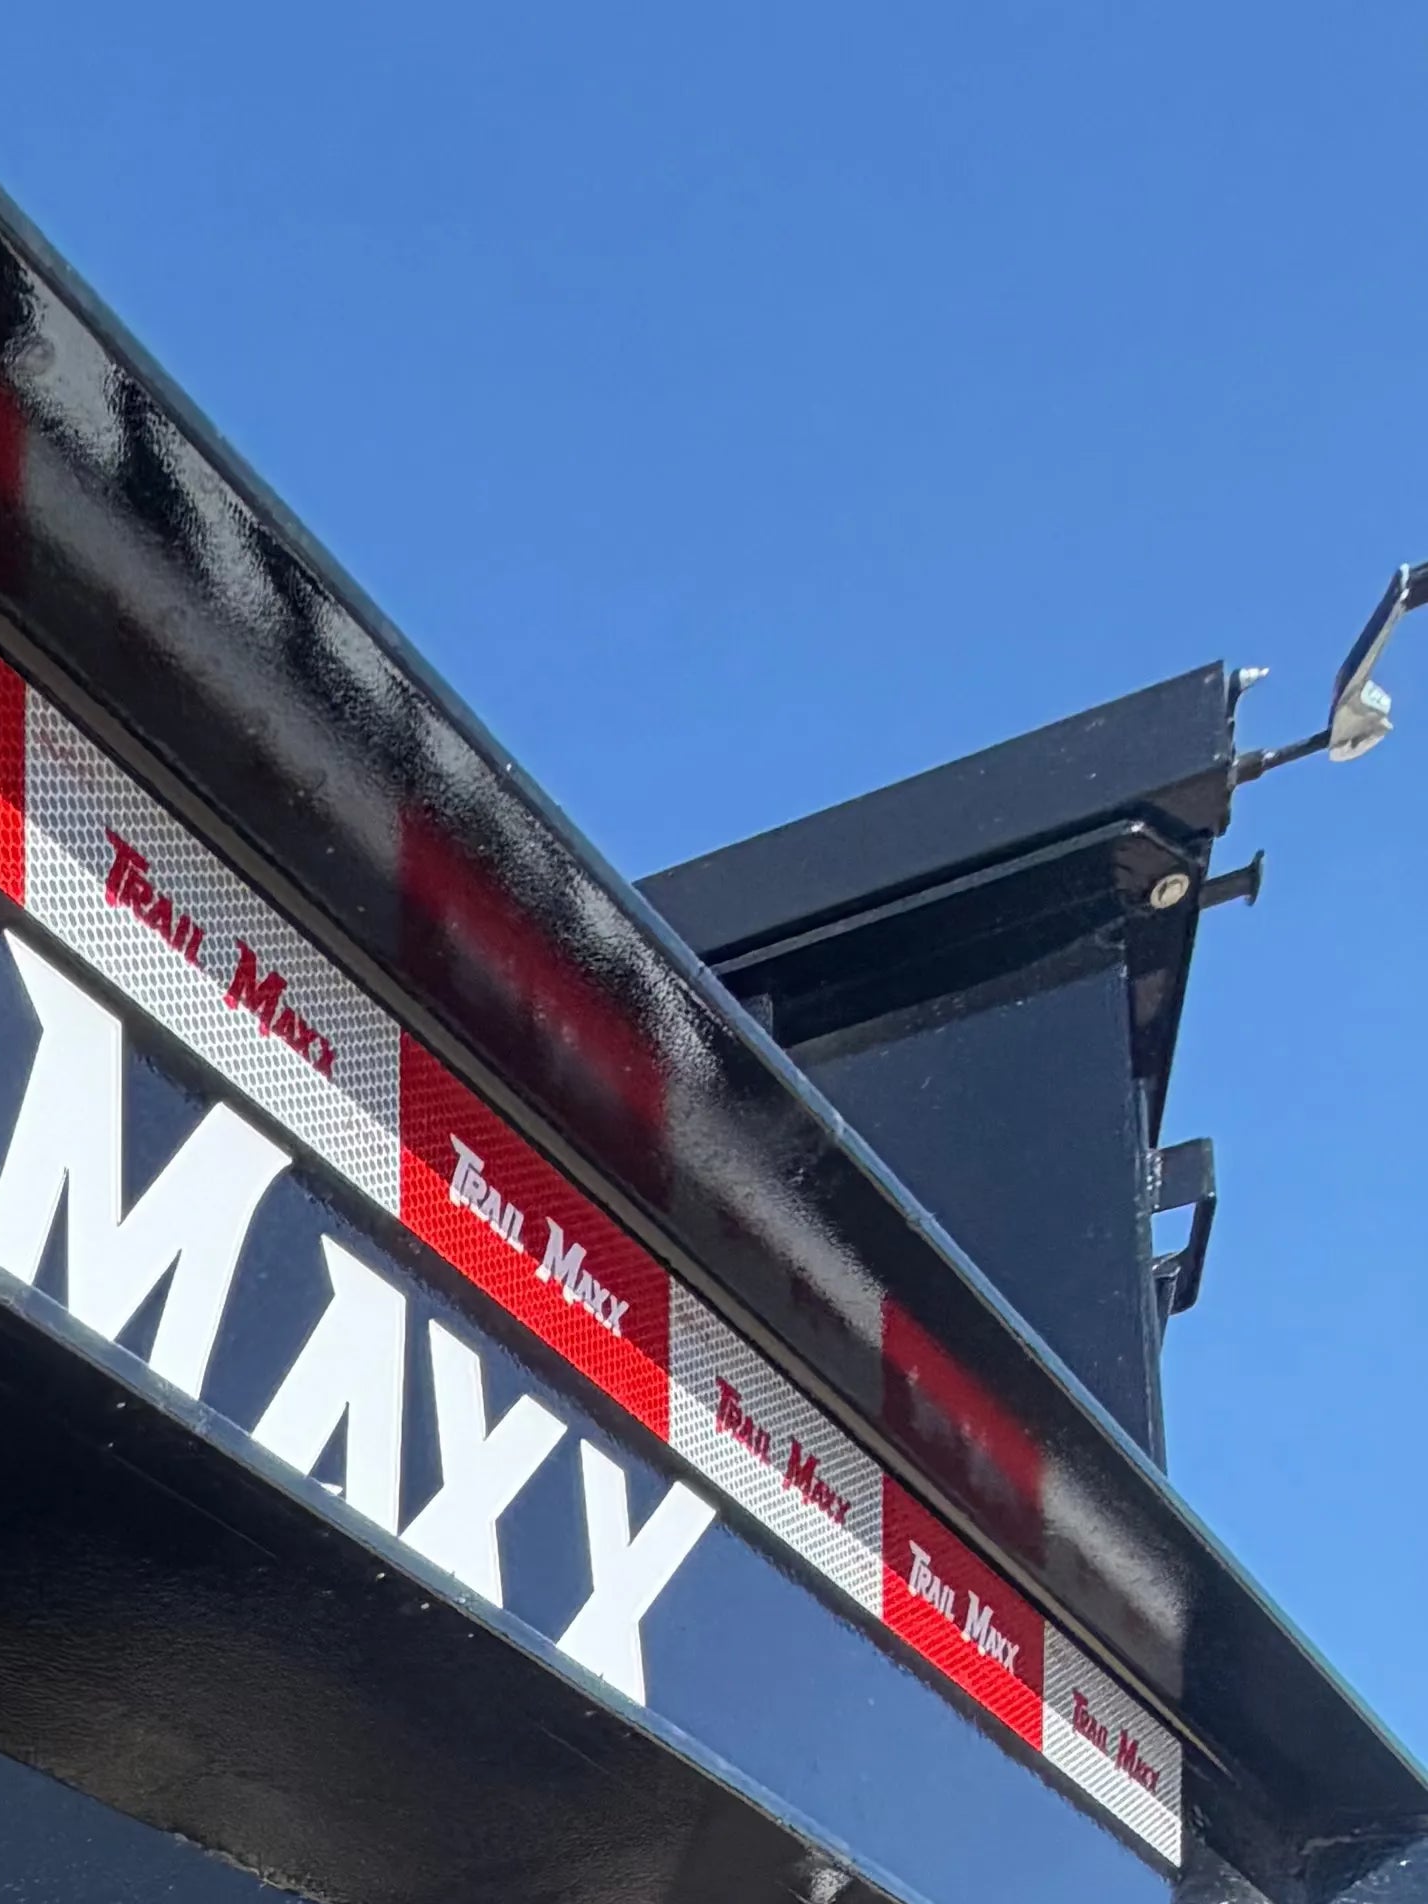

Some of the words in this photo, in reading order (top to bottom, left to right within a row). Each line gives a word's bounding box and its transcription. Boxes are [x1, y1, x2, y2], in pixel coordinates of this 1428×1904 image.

[105, 826, 204, 974] TRAIL
[223, 936, 335, 1081] MAXX
[449, 1132, 525, 1254] TRAIL
[535, 1216, 630, 1337] MAXX
[715, 1376, 771, 1466] TRAIL
[782, 1435, 850, 1525] MAXX
[907, 1539, 956, 1620] TRAIL
[960, 1589, 1020, 1674] MAXX
[1071, 1687, 1108, 1753] TRAIL
[1114, 1729, 1160, 1791] MAXX
